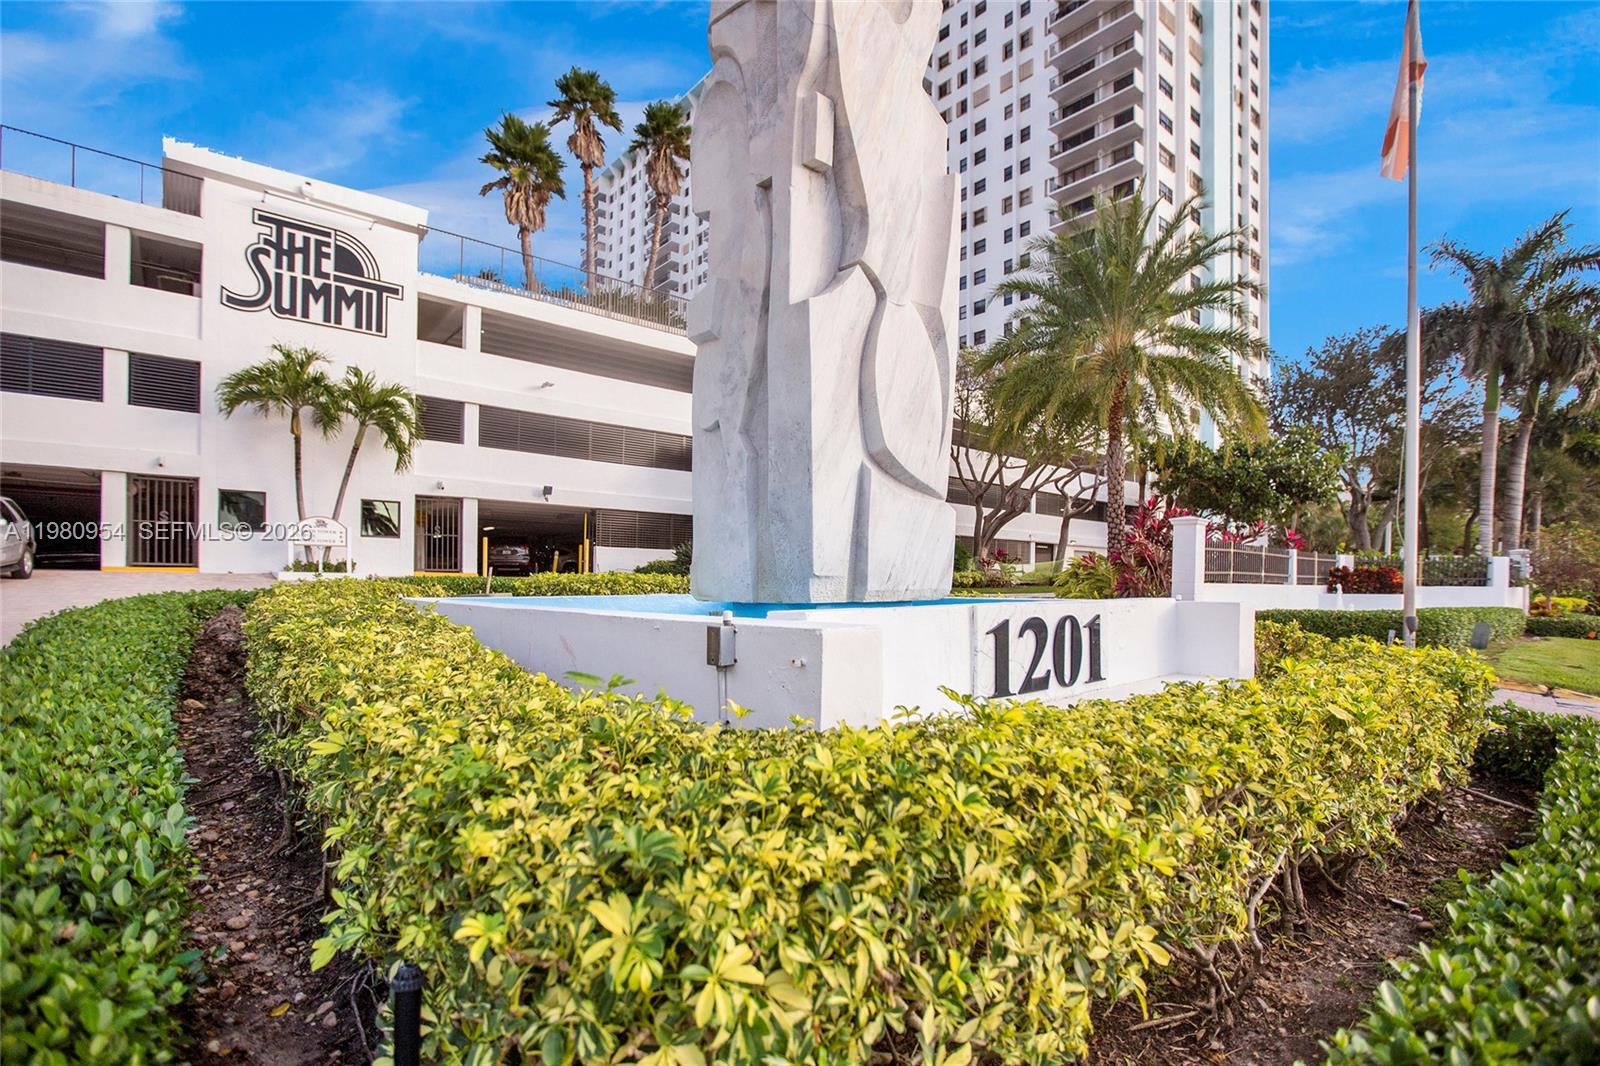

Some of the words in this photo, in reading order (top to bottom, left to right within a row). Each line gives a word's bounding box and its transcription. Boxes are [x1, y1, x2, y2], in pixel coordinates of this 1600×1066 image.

[257, 213, 332, 281] THE
[225, 247, 400, 334] SUMMIT
[985, 614, 1106, 699] 1201
